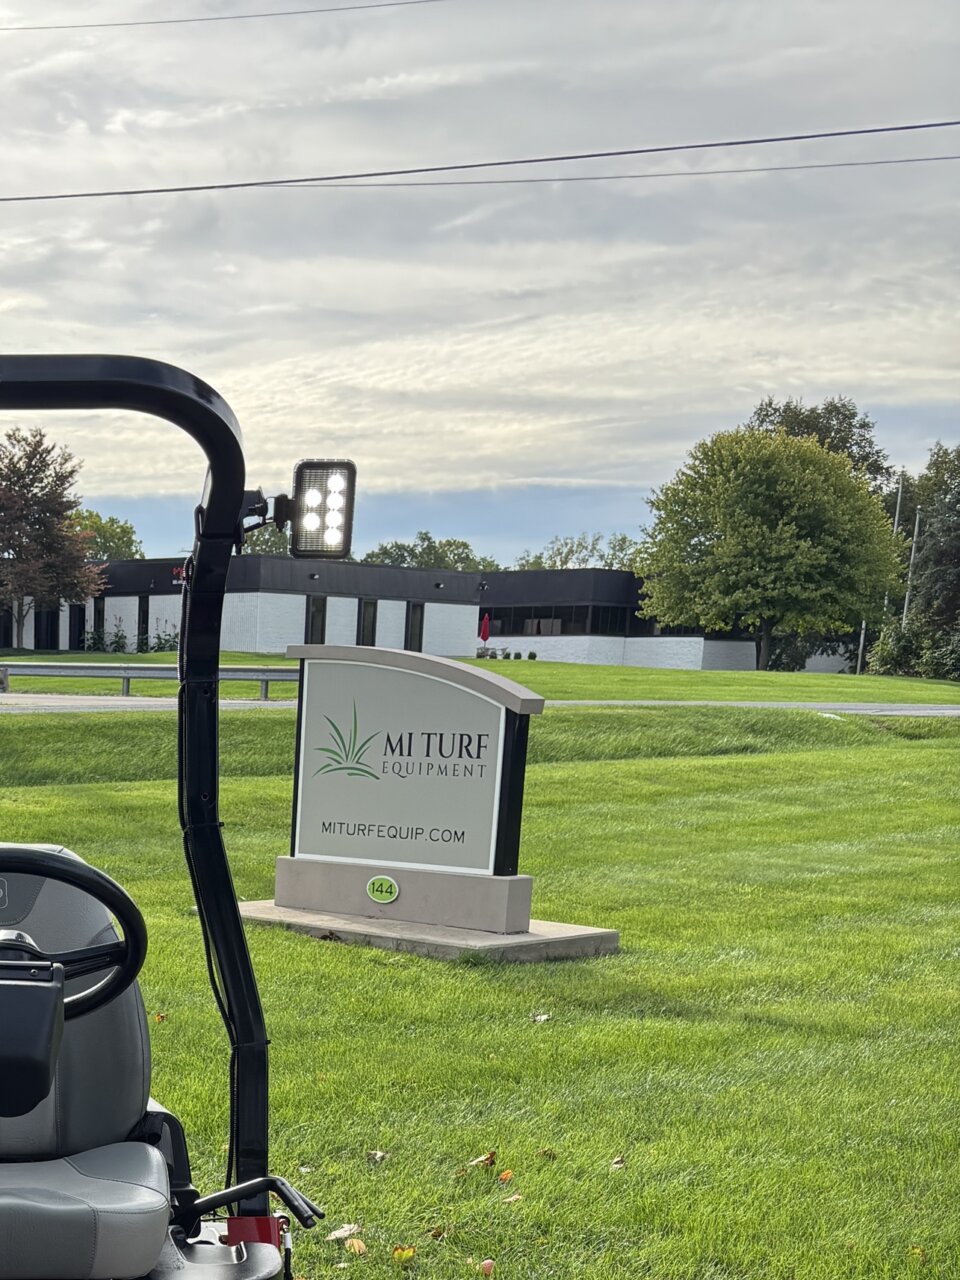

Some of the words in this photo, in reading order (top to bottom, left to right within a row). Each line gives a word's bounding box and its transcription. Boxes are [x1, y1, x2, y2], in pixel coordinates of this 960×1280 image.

[383, 732, 414, 757] MI
[420, 732, 489, 759] TURF
[382, 761, 487, 778] EQUIPMENT
[321, 821, 466, 844] MITURFEQUIP.COM
[371, 881, 394, 896] 144
